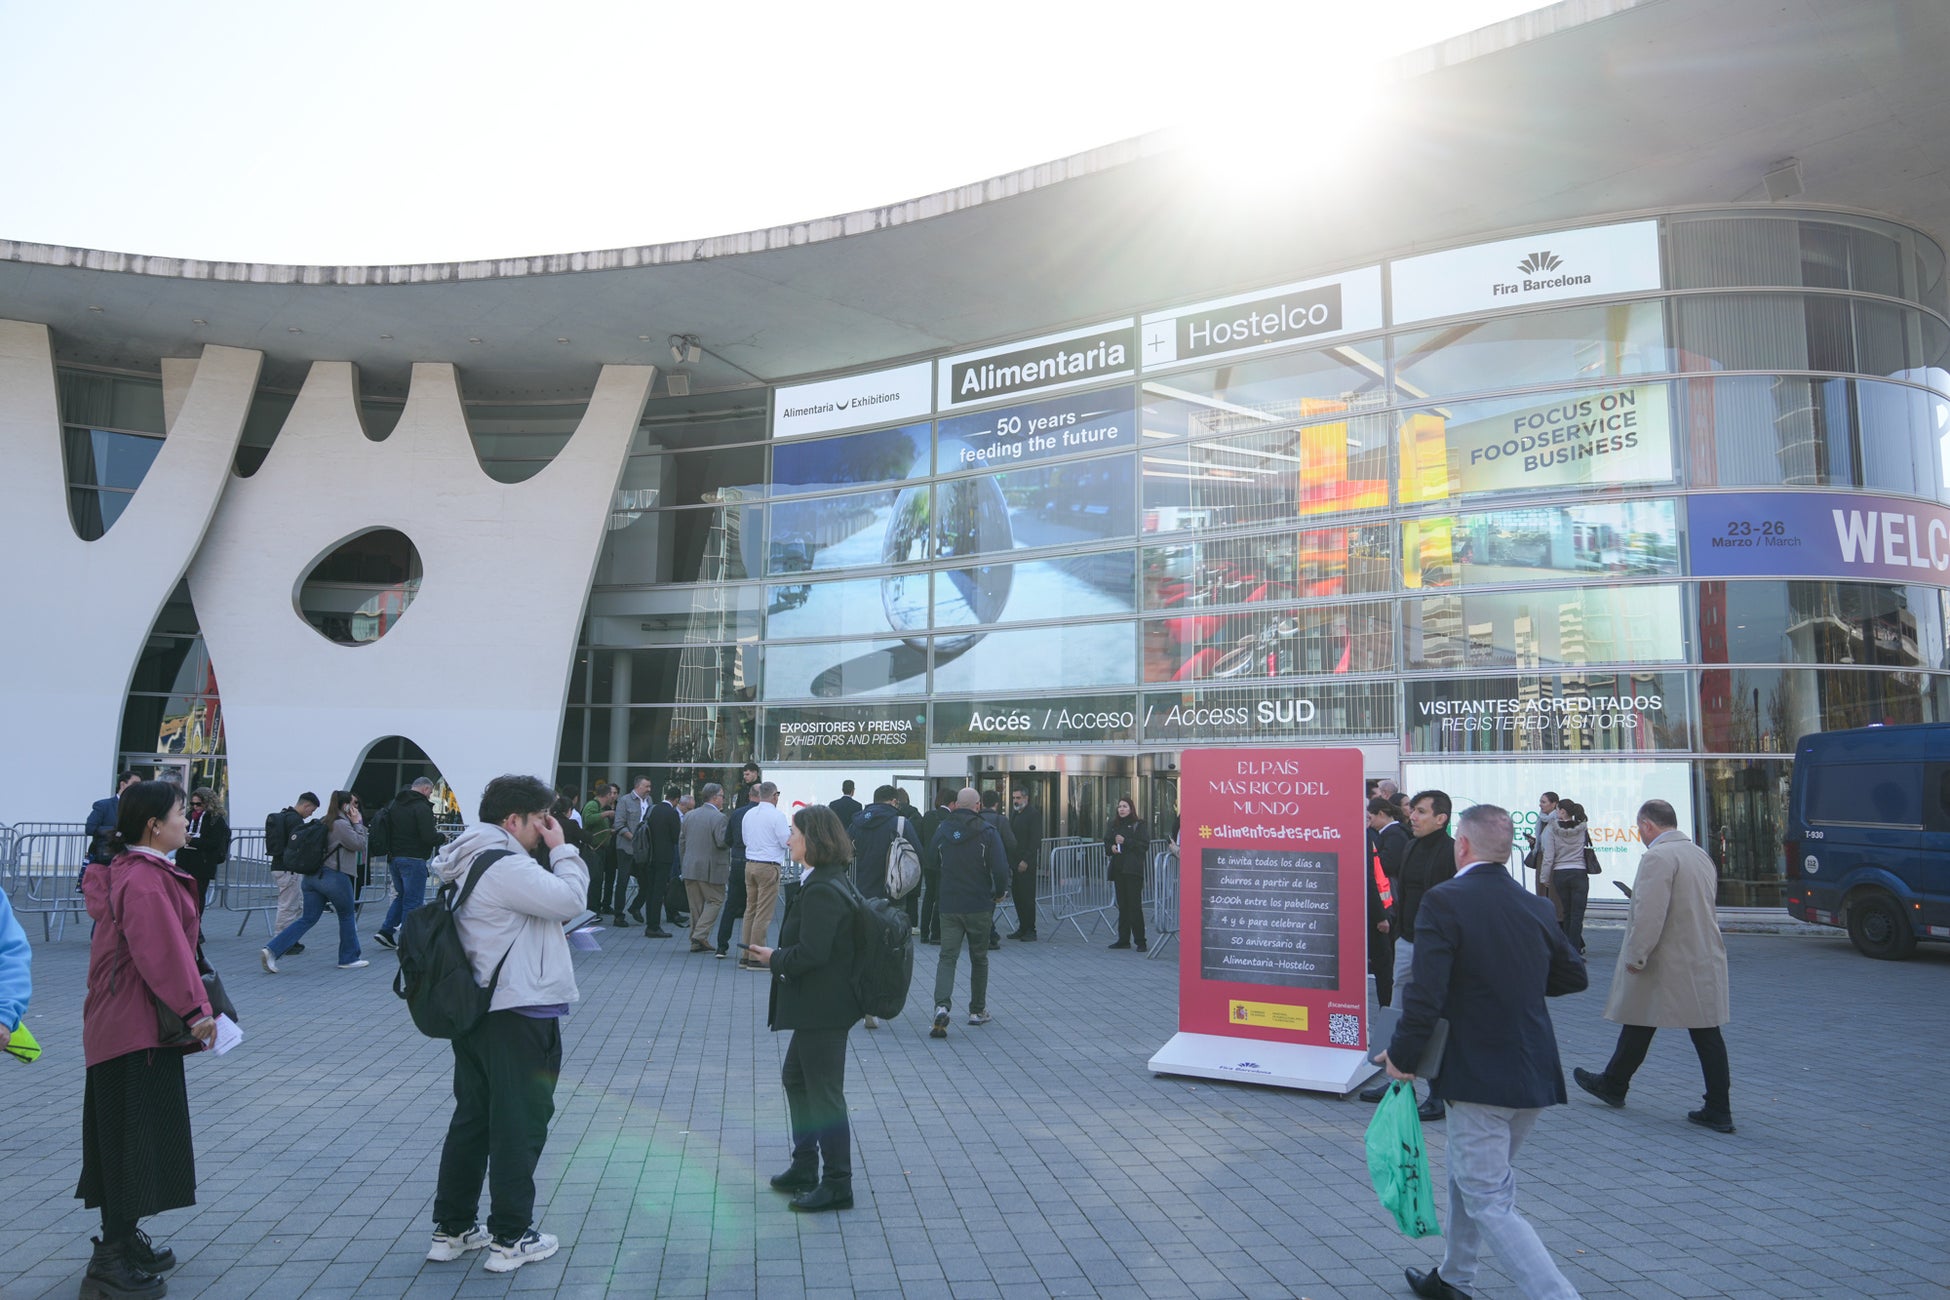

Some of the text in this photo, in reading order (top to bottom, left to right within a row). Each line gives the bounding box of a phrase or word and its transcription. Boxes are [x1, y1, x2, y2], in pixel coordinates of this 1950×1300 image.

[1493, 274, 1591, 296] Fira Barcelona
[961, 341, 1125, 395] Alimentaria
[1189, 303, 1328, 349] Hostelco
[783, 392, 900, 418] Alimentaria Exhibitions
[1514, 390, 1635, 434] FOCUS ON
[997, 412, 1076, 436] 50 years
[960, 426, 1118, 463] feeding the future
[1471, 411, 1637, 465] FOODSERVICE
[1524, 432, 1638, 472] BUSINESS
[1727, 521, 1785, 536] 23-26
[1712, 537, 1753, 547] Marzo
[1765, 535, 1801, 547] March
[1832, 509, 1950, 571] WELC
[1419, 695, 1662, 715] VISITANTES ACREDITADOS
[968, 710, 1031, 732] Accés
[1056, 709, 1133, 729] Acceso
[1164, 705, 1249, 726] Access
[1257, 700, 1315, 723] SUD
[1441, 713, 1638, 731] REGISTERED VISITORS
[780, 720, 912, 734] EXPOSITORES Y PRENSA
[784, 733, 907, 746] EXHIBITORS AND PRESS
[1238, 759, 1299, 775] EL PAÍS
[1209, 779, 1330, 796] MÁS RICO DEL
[1233, 801, 1299, 816] MUNDO
[1217, 856, 1225, 865] te
[1228, 856, 1252, 866] invita
[1255, 857, 1278, 867] todos
[1280, 857, 1292, 867] los
[1295, 858, 1313, 868] días
[1220, 876, 1252, 885] churros
[1263, 878, 1289, 889] partir
[1292, 879, 1303, 888] de
[1305, 879, 1318, 889] las
[1210, 896, 1329, 910] 10:00h entre los pabellones
[1221, 916, 1317, 930] 4 y 6 para celebrar el
[1231, 937, 1307, 949] 50 aniversario de
[1223, 955, 1315, 971] Alimentaria-Hostelco
